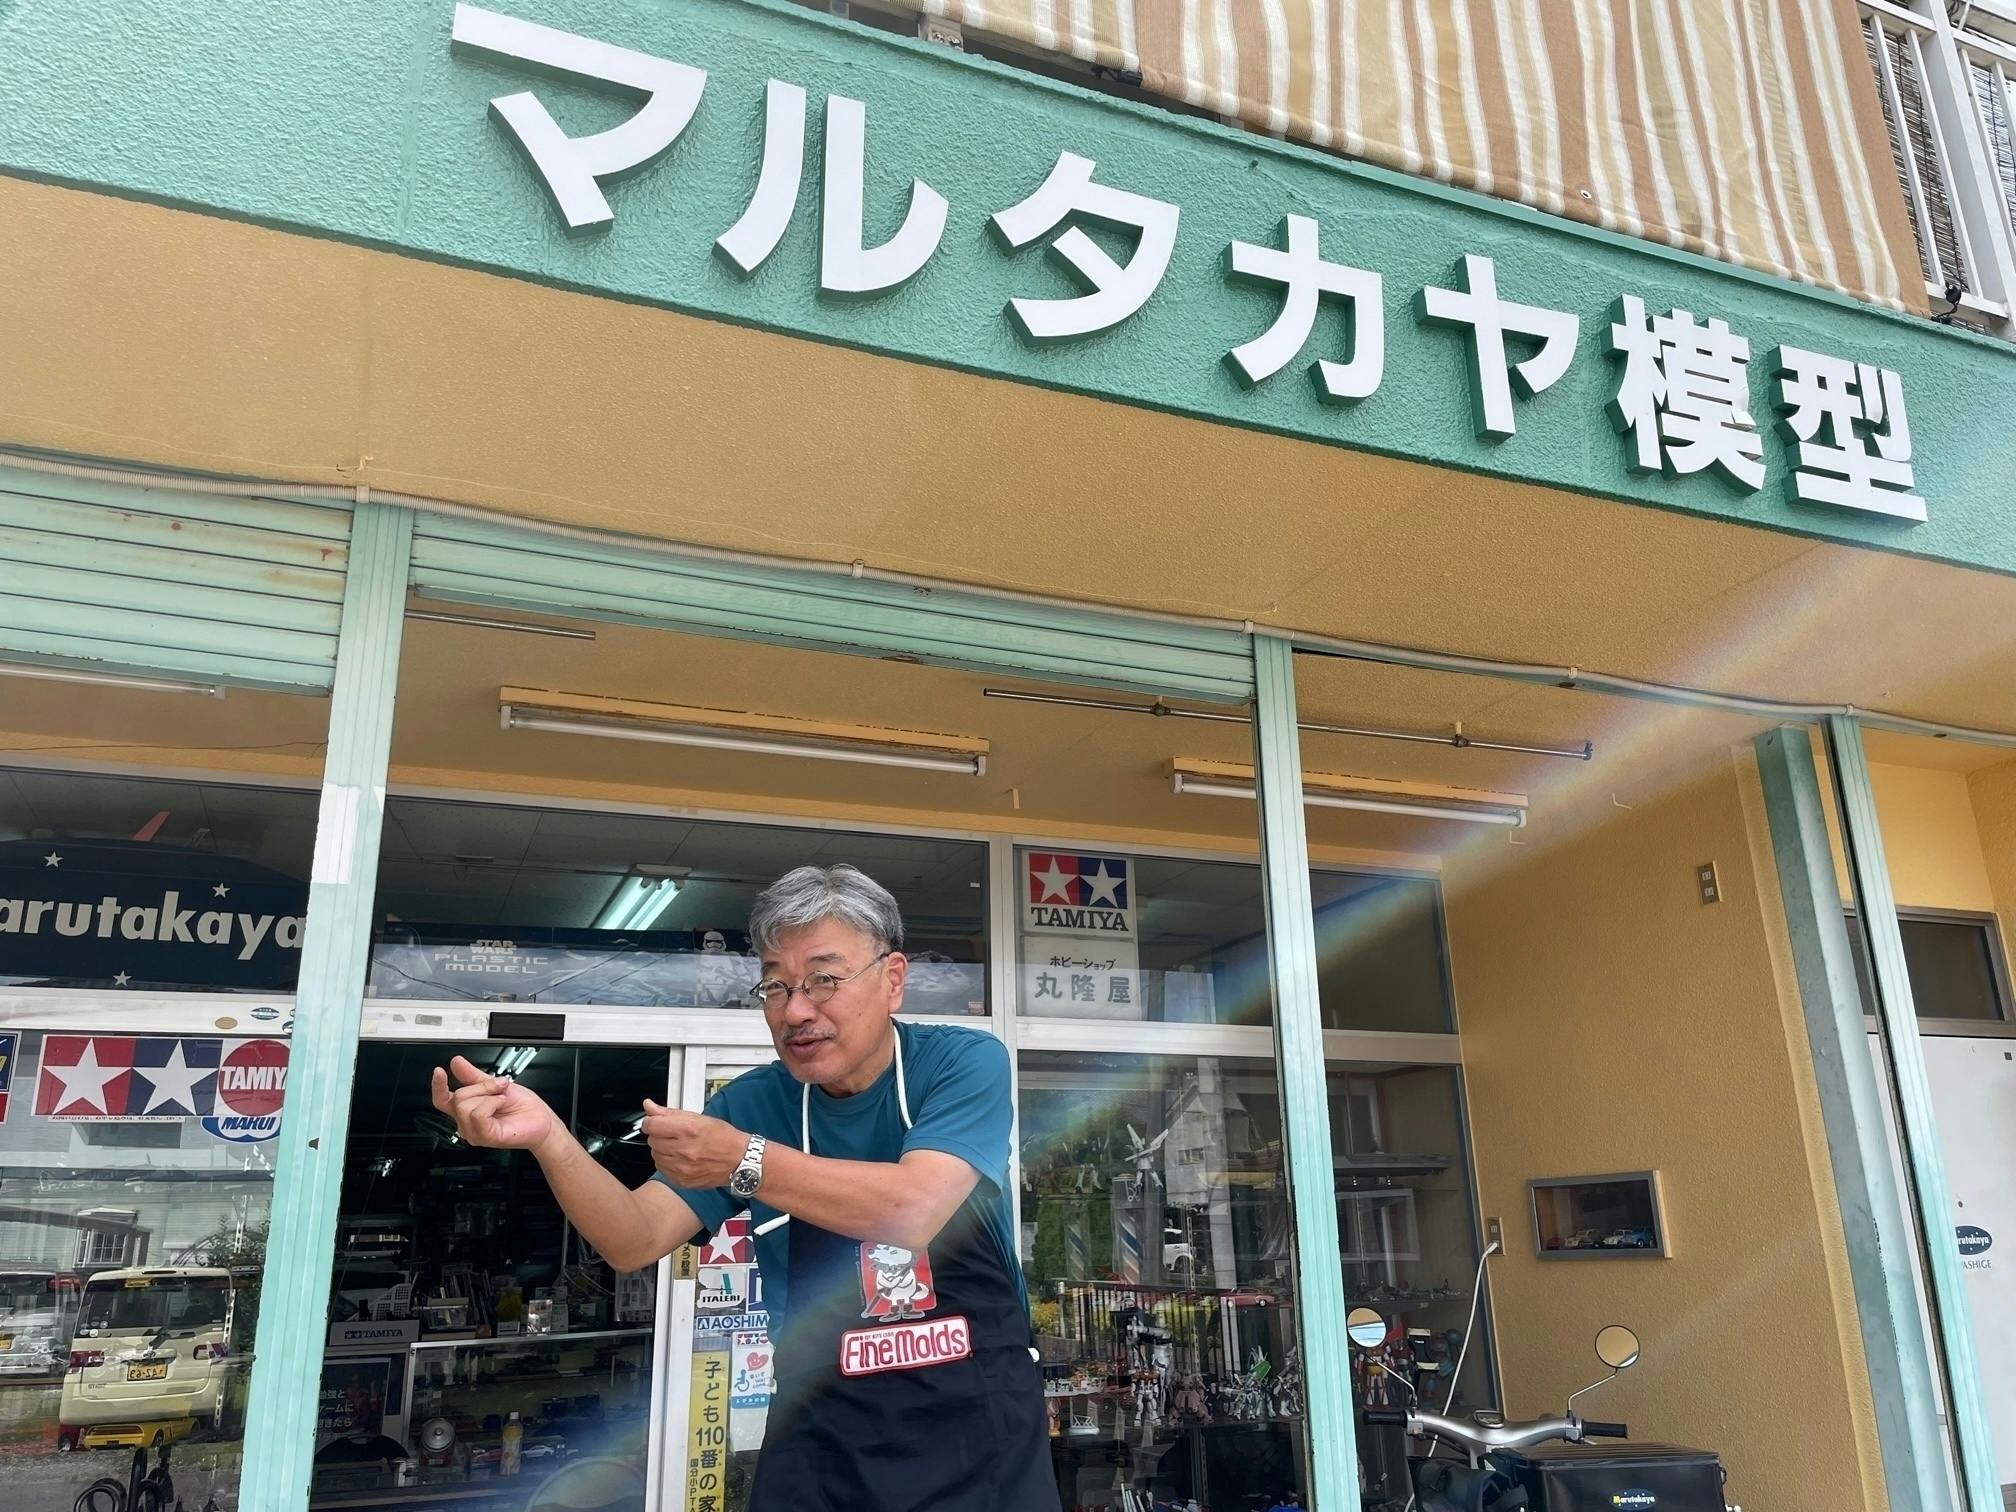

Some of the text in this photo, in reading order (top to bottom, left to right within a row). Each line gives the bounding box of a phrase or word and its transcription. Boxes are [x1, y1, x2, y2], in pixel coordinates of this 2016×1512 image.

[449, 1, 1929, 523] マルタカヤ模型
[1030, 907, 1129, 932] TAMIYA
[470, 939, 515, 948] STAR
[470, 946, 516, 955] WARS
[434, 953, 549, 965] PLASTIC
[444, 963, 537, 974] MODEL
[1034, 971, 1131, 1004] 丸隆屋
[220, 1066, 288, 1091] TAMIY
[702, 1294, 740, 1303] ITALERI
[364, 1328, 403, 1339] TAMIYA
[695, 1360, 724, 1512] 子ども110番の家
